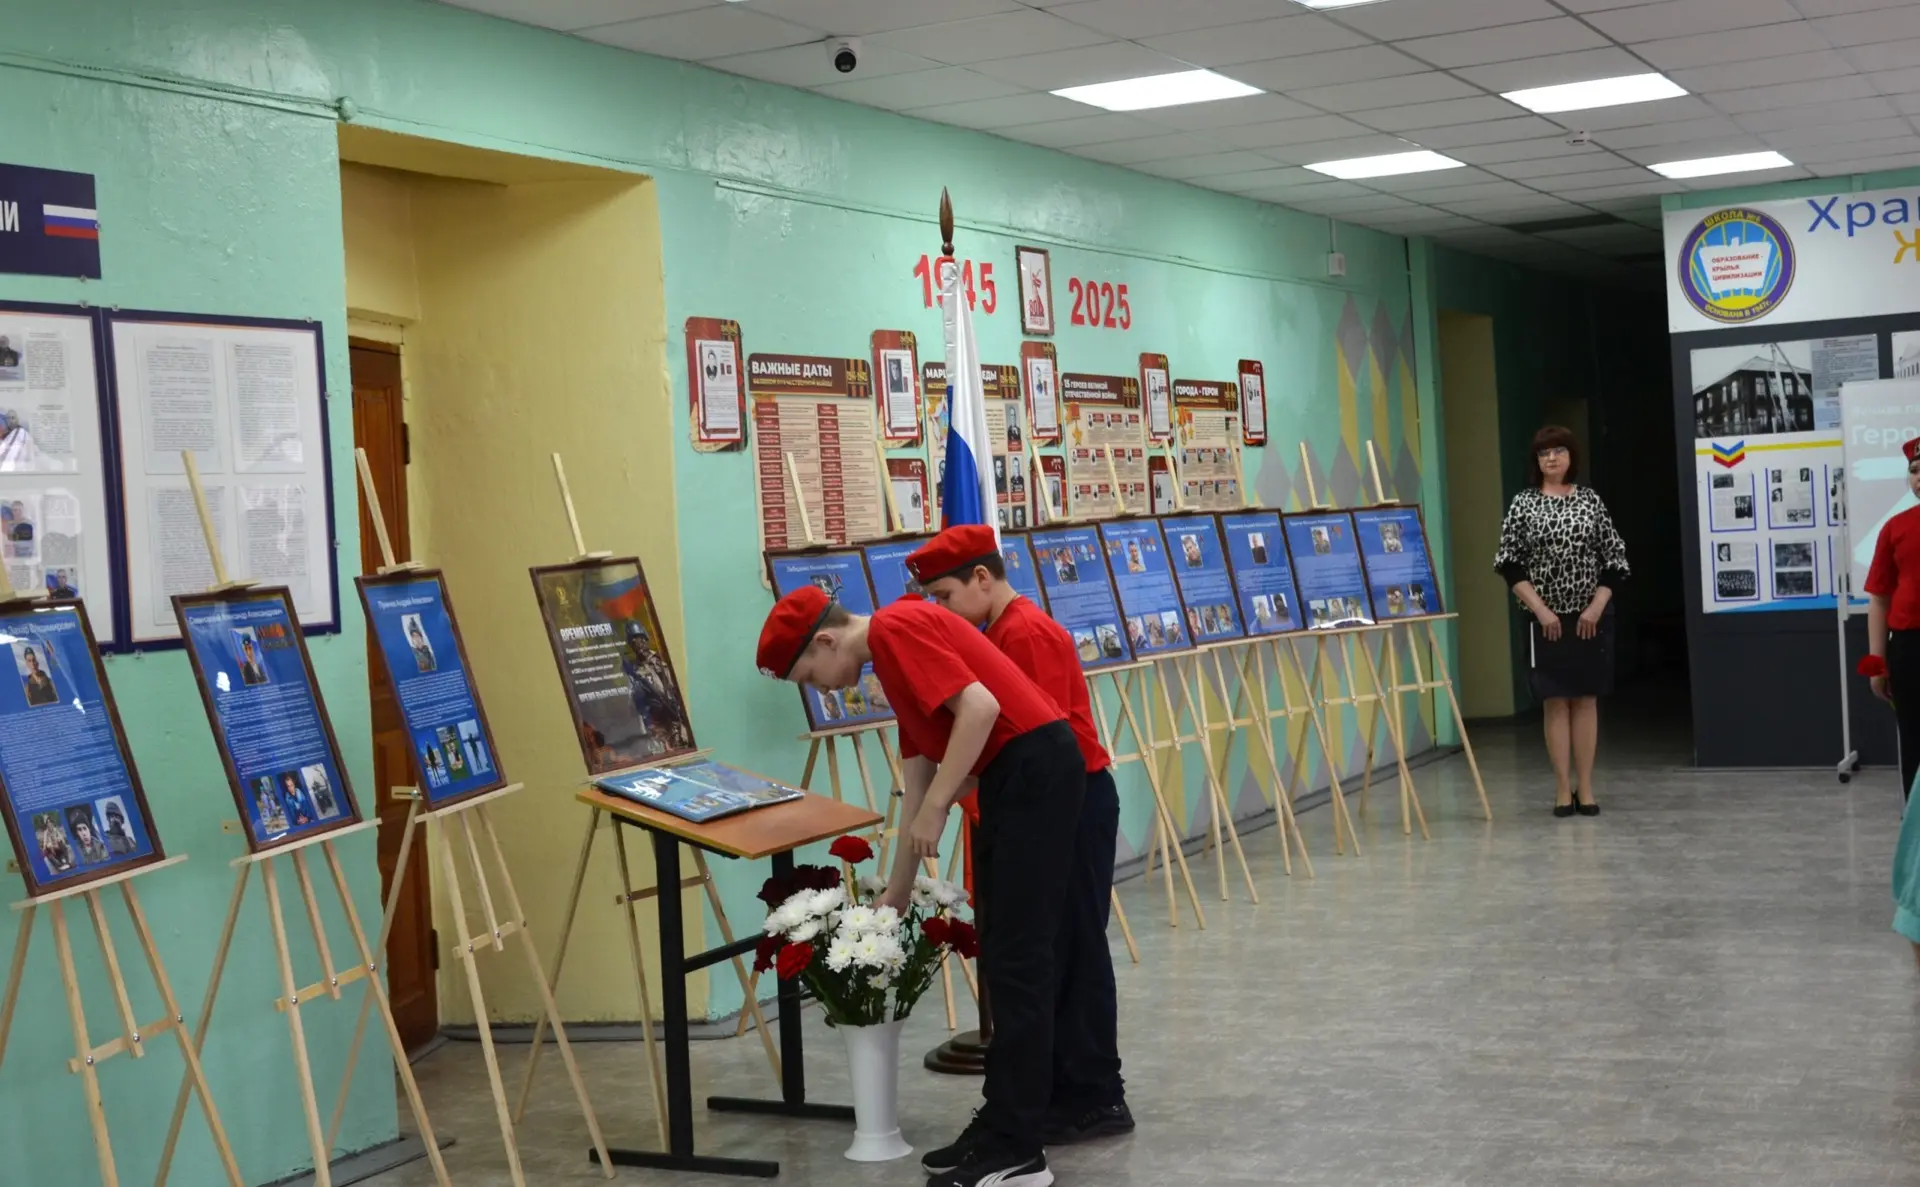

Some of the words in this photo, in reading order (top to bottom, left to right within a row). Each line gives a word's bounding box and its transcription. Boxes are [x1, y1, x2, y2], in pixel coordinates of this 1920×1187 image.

[1807, 195, 1920, 238] Хра
[1711, 253, 1760, 264] ОБРАЗОВАНИЕ
[1712, 264, 1740, 272] КРЫЛЬЯ
[1712, 271, 1763, 281] ЦИВИЛИЗАЦИИ
[1068, 277, 1131, 329] 2025
[751, 361, 801, 376] ВАЖНЫЕ
[803, 364, 832, 378] ДАТЫ
[1175, 386, 1199, 397] ГОРОДА
[1201, 386, 1219, 397] ГЕРОИ
